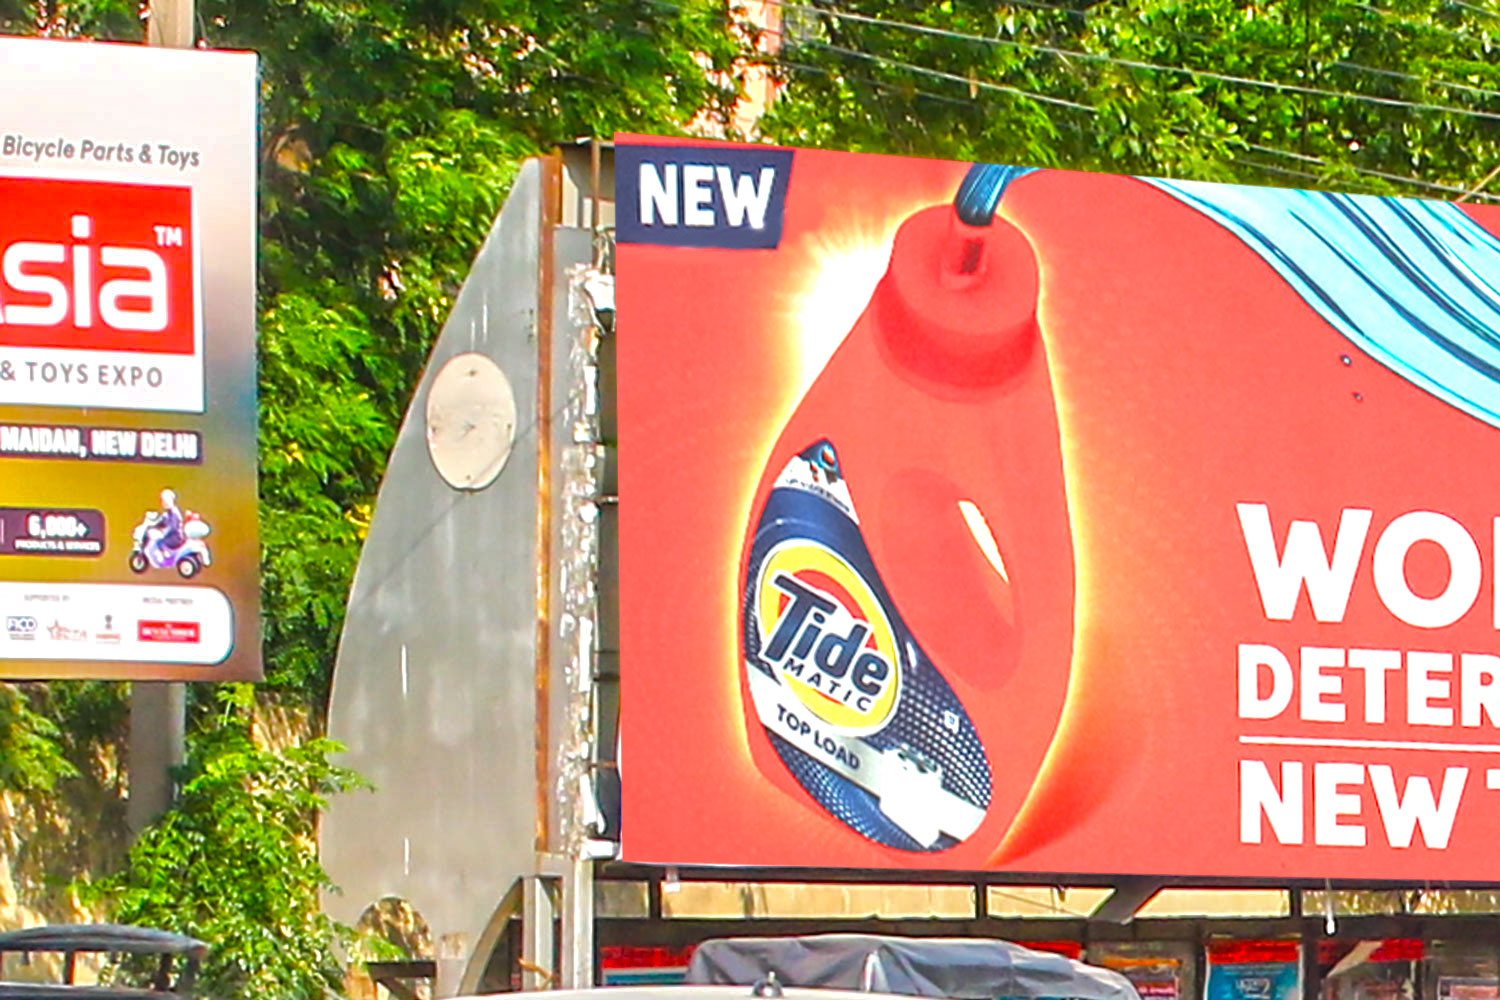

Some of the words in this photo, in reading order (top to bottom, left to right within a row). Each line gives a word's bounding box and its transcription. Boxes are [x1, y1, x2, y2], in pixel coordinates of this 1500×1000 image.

[3, 135, 76, 162] Bicycle
[80, 139, 134, 163] Parts
[138, 143, 152, 164] &
[158, 144, 200, 171] Toys
[640, 162, 775, 230] NEW
[0, 215, 168, 332] sia
[0, 360, 16, 382] &
[25, 361, 88, 384] TOYS
[98, 364, 163, 388] EXPO
[0, 425, 87, 459] MAIDAN,
[91, 429, 137, 456] NEW
[140, 431, 198, 460] DELHI
[764, 574, 889, 697] Tide
[782, 657, 872, 712] MATIC
[776, 703, 811, 736] TOP
[814, 730, 861, 770] LOAD
[1240, 760, 1469, 850] NEW
